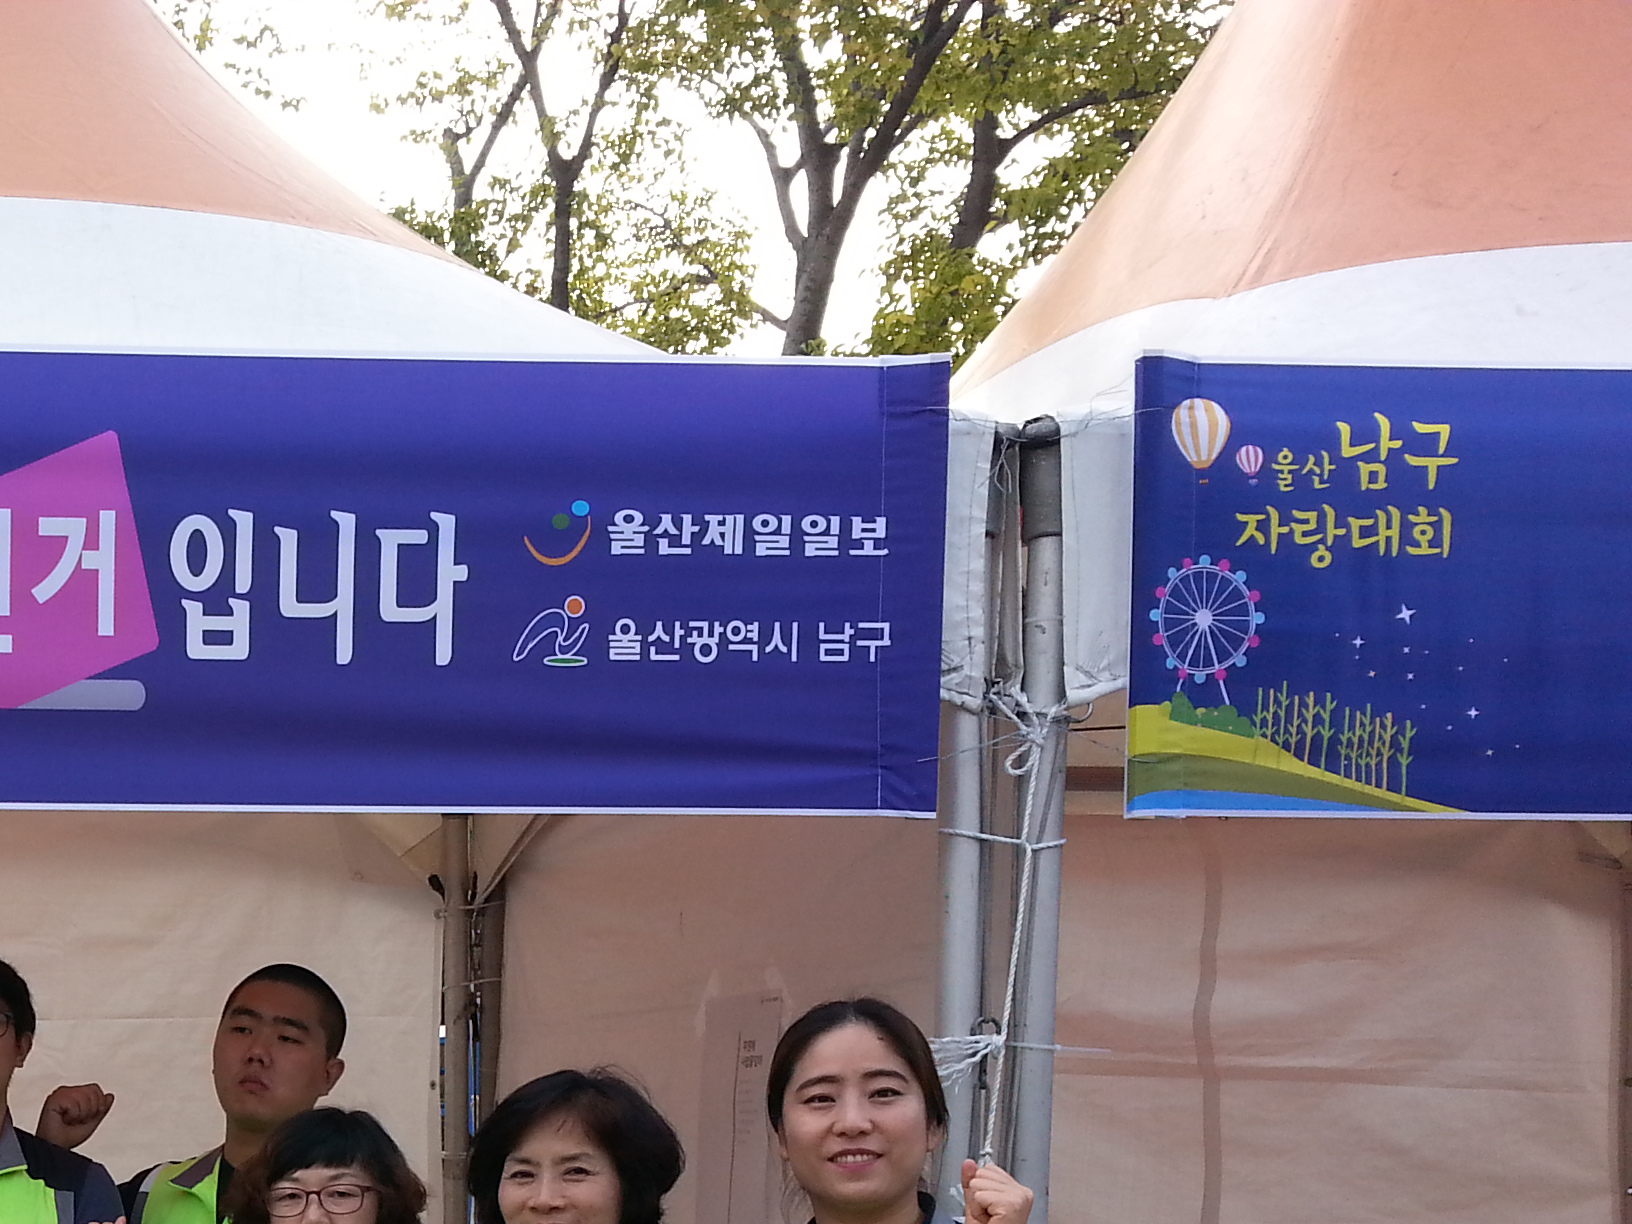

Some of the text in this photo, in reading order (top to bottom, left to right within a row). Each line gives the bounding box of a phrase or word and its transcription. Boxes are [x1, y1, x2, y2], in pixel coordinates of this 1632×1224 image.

[1271, 412, 1460, 492] 울산 남구
[607, 508, 890, 557] 울산제일일보
[1235, 503, 1453, 568] 자랑대회
[168, 508, 468, 667] 입니다
[607, 617, 893, 663] 울산광역시 남구
